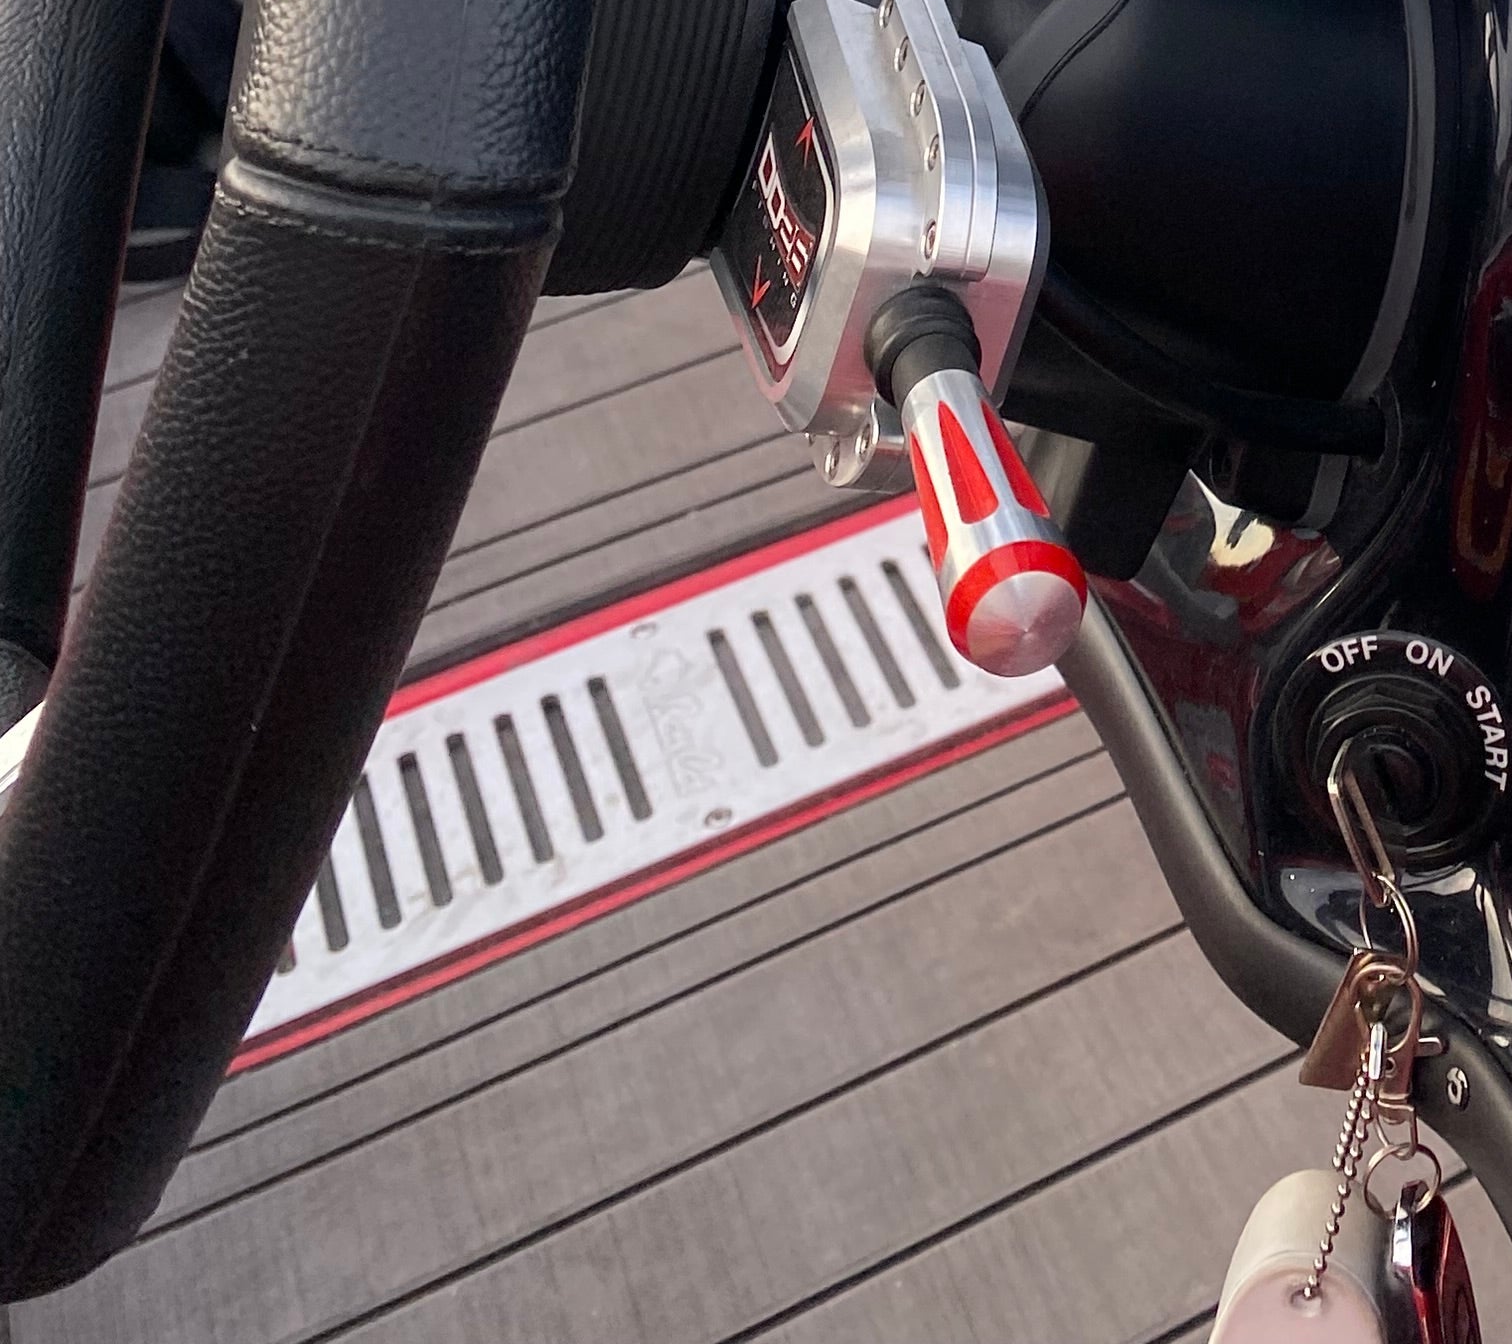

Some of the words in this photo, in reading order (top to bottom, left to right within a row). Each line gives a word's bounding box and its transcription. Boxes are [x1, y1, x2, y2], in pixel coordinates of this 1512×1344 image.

[1320, 635, 1379, 673] OFF
[1405, 639, 1455, 677] ON
[1465, 684, 1510, 793] START
